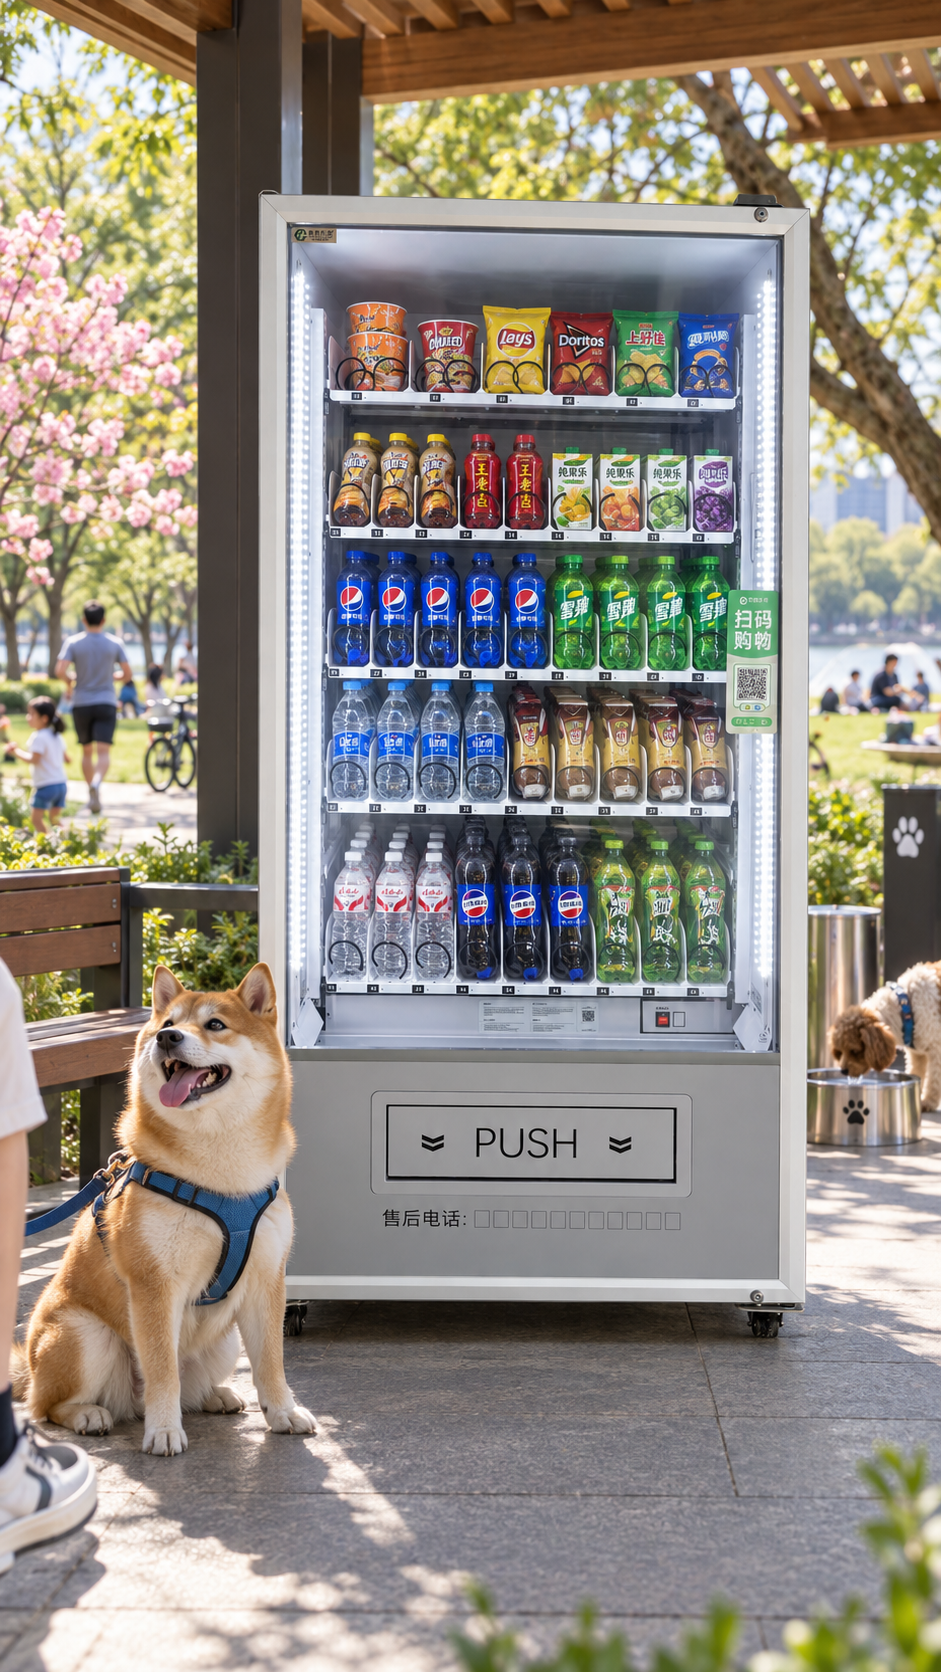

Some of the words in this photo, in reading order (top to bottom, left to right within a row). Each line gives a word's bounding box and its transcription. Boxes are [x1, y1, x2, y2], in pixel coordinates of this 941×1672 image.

[559, 334, 605, 347] Doritos
[734, 609, 772, 629] 扫码
[733, 630, 772, 651] 购物
[475, 1127, 578, 1159] PUSH
[382, 1209, 467, 1228] 售后电话:
